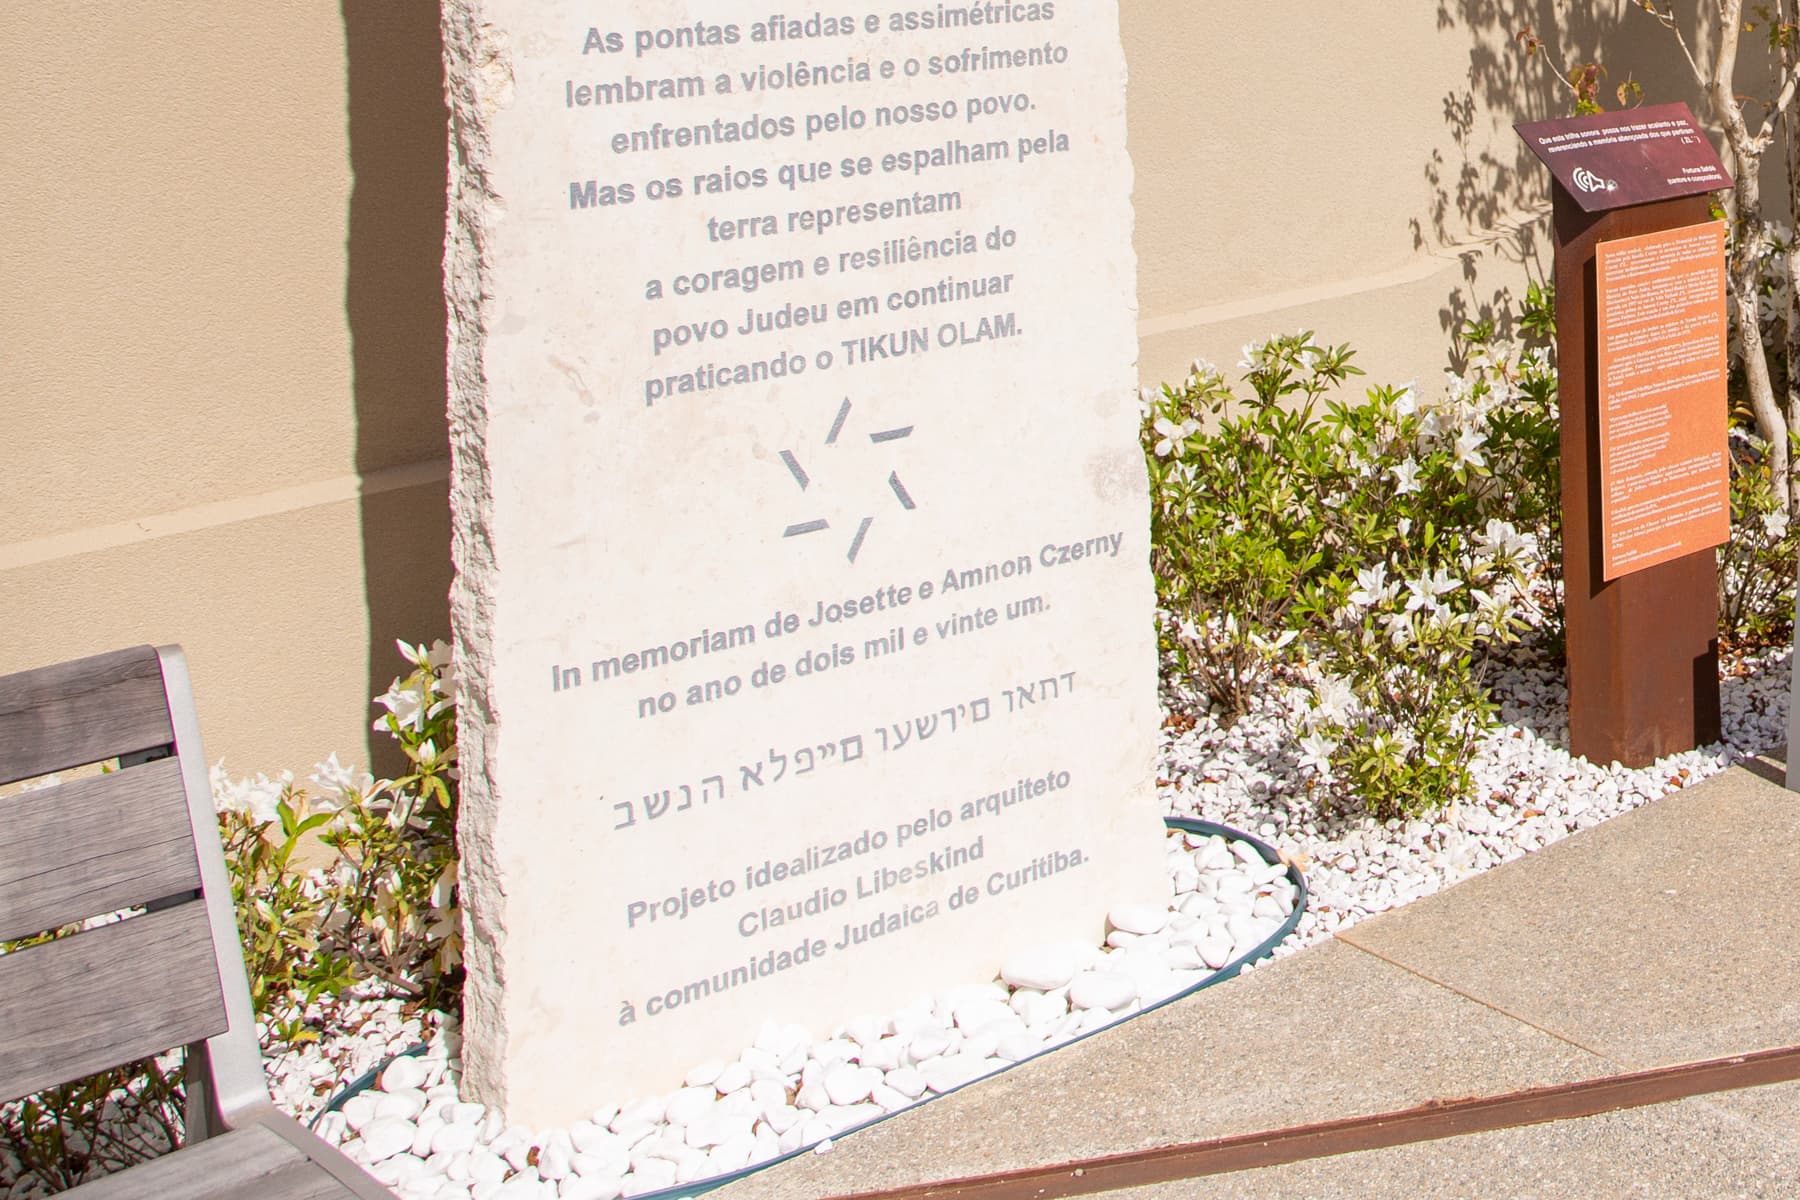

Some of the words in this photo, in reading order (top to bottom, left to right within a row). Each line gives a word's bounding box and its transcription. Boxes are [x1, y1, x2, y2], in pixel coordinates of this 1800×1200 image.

[565, 75, 705, 109] lembram
[714, 73, 733, 96] a
[740, 56, 871, 92] violência
[879, 60, 896, 80] e
[903, 57, 921, 77] o
[927, 41, 1069, 76] sofrimento
[581, 26, 625, 56] As
[635, 20, 742, 59] pontas
[750, 11, 856, 43] afiadas
[864, 13, 881, 34] e
[610, 113, 796, 155] enfrentados
[805, 104, 867, 141] pelo
[875, 99, 959, 127] nosso
[966, 93, 1036, 124] povo.
[569, 179, 636, 211] Mas
[645, 177, 684, 201] os
[693, 164, 769, 196] raios
[777, 161, 833, 192] que
[839, 156, 873, 179] se
[880, 139, 1010, 176] espalham
[1017, 128, 1070, 164] pela
[706, 215, 779, 243] terra
[787, 191, 962, 236] representam
[645, 279, 664, 301] a
[672, 259, 805, 296] coragem
[813, 255, 830, 276] e
[839, 229, 978, 273] resiliência
[984, 224, 1017, 251] do
[653, 319, 729, 357] povo
[737, 302, 828, 336] Judeu
[836, 295, 879, 320] em
[886, 273, 1015, 312] continuar
[645, 350, 807, 408] praticando
[815, 350, 834, 371] o
[840, 326, 929, 366] TIKUN
[936, 312, 1023, 348] OLAM.
[551, 664, 582, 693] In
[591, 624, 756, 683] memoriam
[764, 610, 801, 639] de
[807, 583, 913, 628] Josette
[918, 580, 934, 601] e
[940, 555, 1033, 595] Amnon
[1039, 531, 1124, 568] Czerny
[638, 691, 677, 719] no
[685, 675, 742, 706] ano
[750, 660, 787, 689] de
[795, 642, 856, 677] dois
[864, 626, 905, 660] mil
[912, 626, 929, 647] e
[935, 607, 999, 640] vinte
[1006, 595, 1051, 621] um.
[627, 879, 737, 929] Projeto
[745, 829, 889, 891] idealizado
[896, 807, 953, 848] pelo
[960, 770, 1071, 822] arquiteto
[737, 886, 848, 938] Claudio
[856, 834, 985, 900] Libeskind
[618, 999, 637, 1027] à
[645, 937, 828, 1017] comunidade
[833, 900, 939, 951] Judaica
[948, 884, 980, 911] de
[986, 848, 1089, 896] Curitiba.
